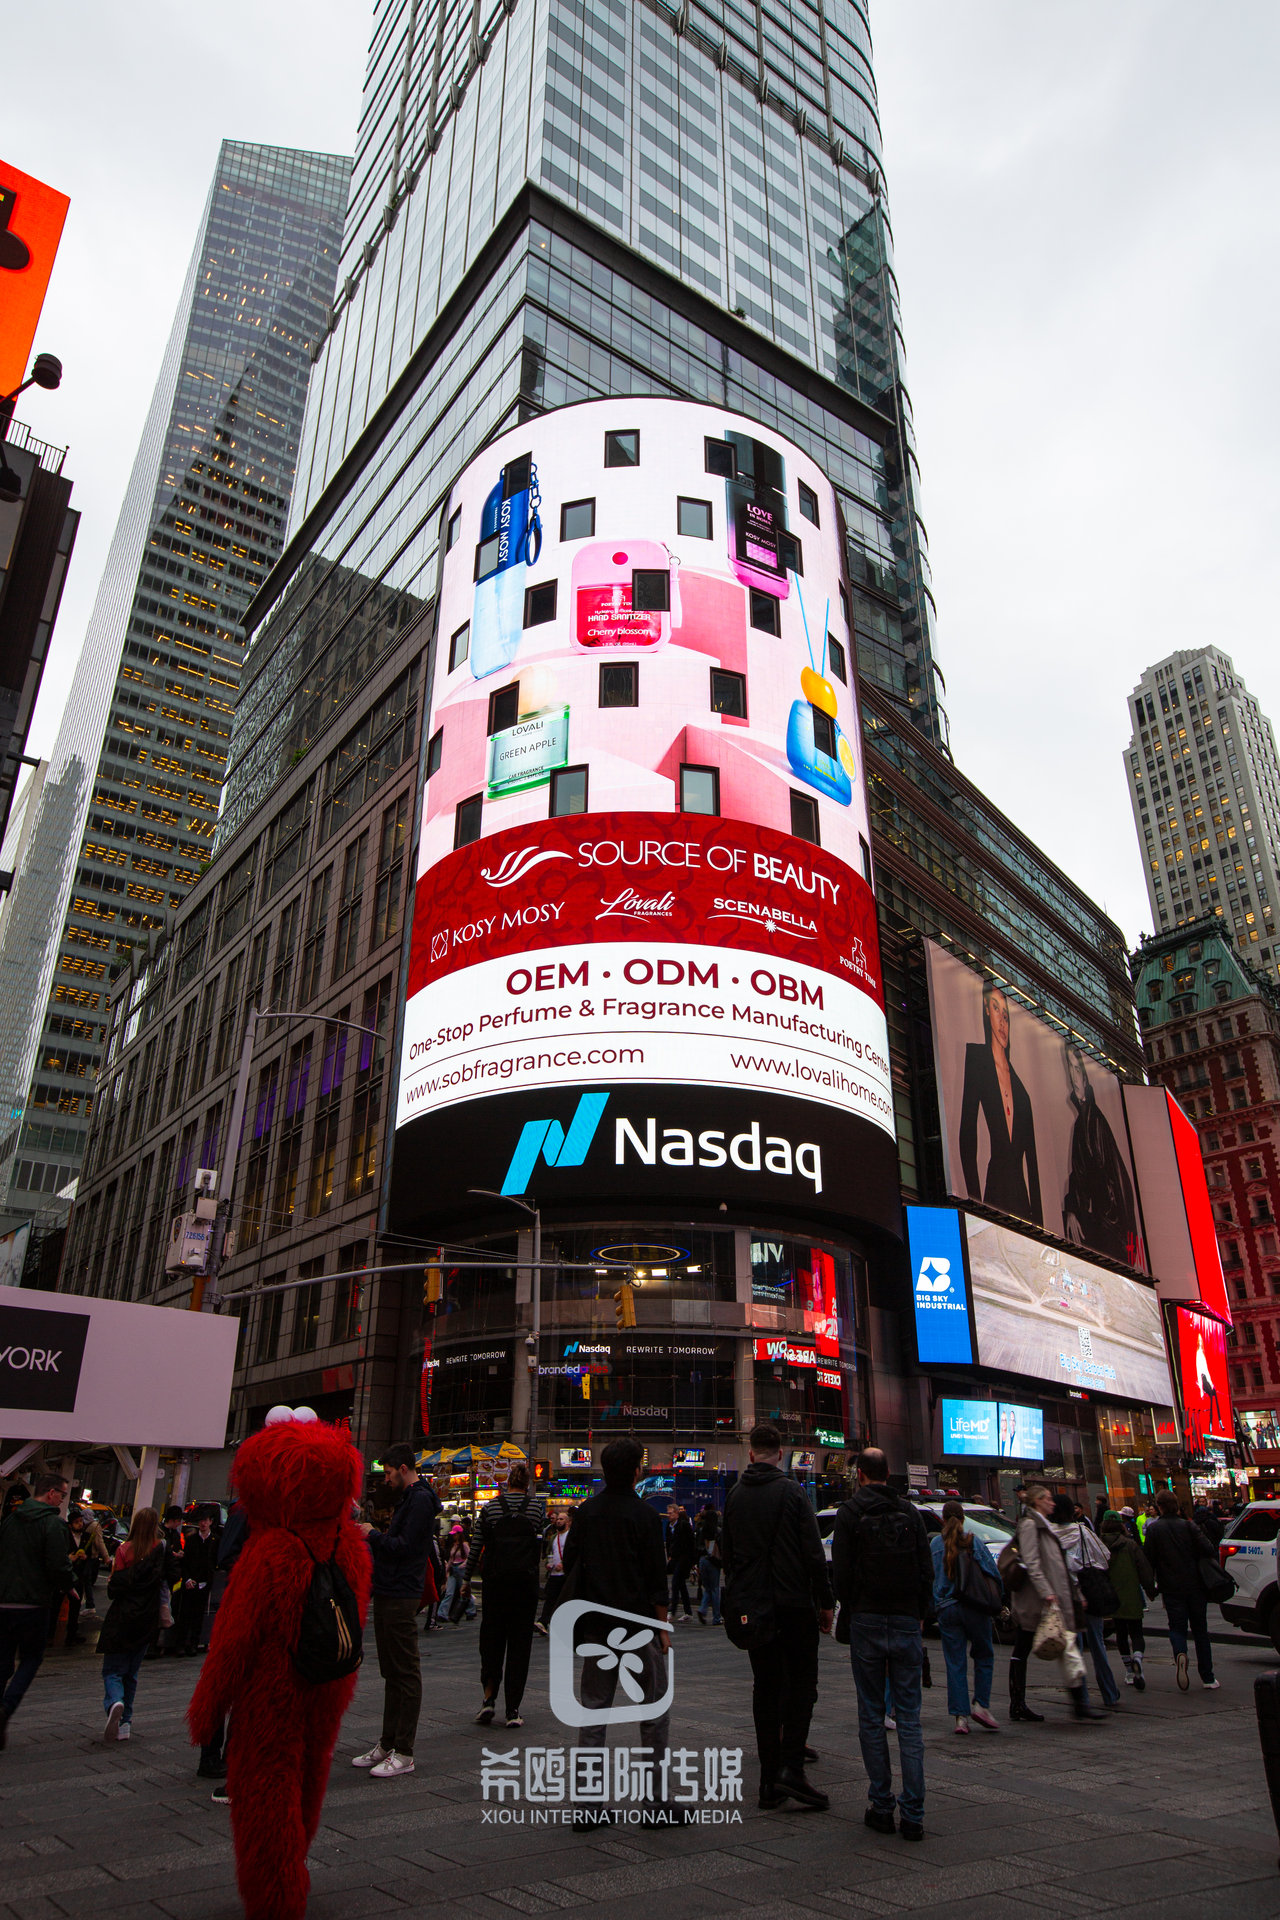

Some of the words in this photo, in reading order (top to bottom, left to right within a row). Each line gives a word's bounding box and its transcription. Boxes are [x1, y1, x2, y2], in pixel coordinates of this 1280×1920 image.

[500, 498, 511, 528] KOSY
[746, 503, 773, 522] LOVE
[745, 531, 760, 541] KOSY
[498, 531, 509, 562] MOSY
[588, 614, 609, 622] HAND
[611, 613, 651, 621] SANITIZER
[587, 628, 616, 637] Cherry
[617, 627, 653, 636] blossom
[512, 721, 544, 737] LOVALI
[499, 746, 527, 761] GREEN
[528, 737, 557, 753] APPLE
[578, 840, 701, 868] SOURCE
[706, 845, 747, 873] OF
[753, 852, 841, 906] BEAUTY
[452, 915, 497, 947] KOSY
[501, 901, 566, 931] MOSY
[713, 897, 819, 933] SCENABELLA
[839, 955, 864, 977] POETRY
[506, 960, 589, 996] OEM
[623, 958, 720, 989] ODM
[750, 969, 825, 1011] OBM
[409, 1022, 474, 1060] One-Stop
[479, 1004, 573, 1033] Perfume
[579, 999, 595, 1017] &
[602, 998, 725, 1020] Fragrance
[732, 1004, 863, 1059] Manufacturing
[406, 1048, 645, 1104] www.sobfragrance.com
[615, 1117, 823, 1195] Nasdaq
[916, 1294, 931, 1302] BIG
[932, 1295, 949, 1303] SKY
[916, 1302, 967, 1311] INDUSTRIAL
[578, 1344, 612, 1355] Nasdaq
[626, 1346, 664, 1354] REWRITE
[667, 1346, 716, 1355] TOMORROW
[622, 1404, 669, 1419] Nasdaq
[950, 1416, 990, 1433] LifeMD
